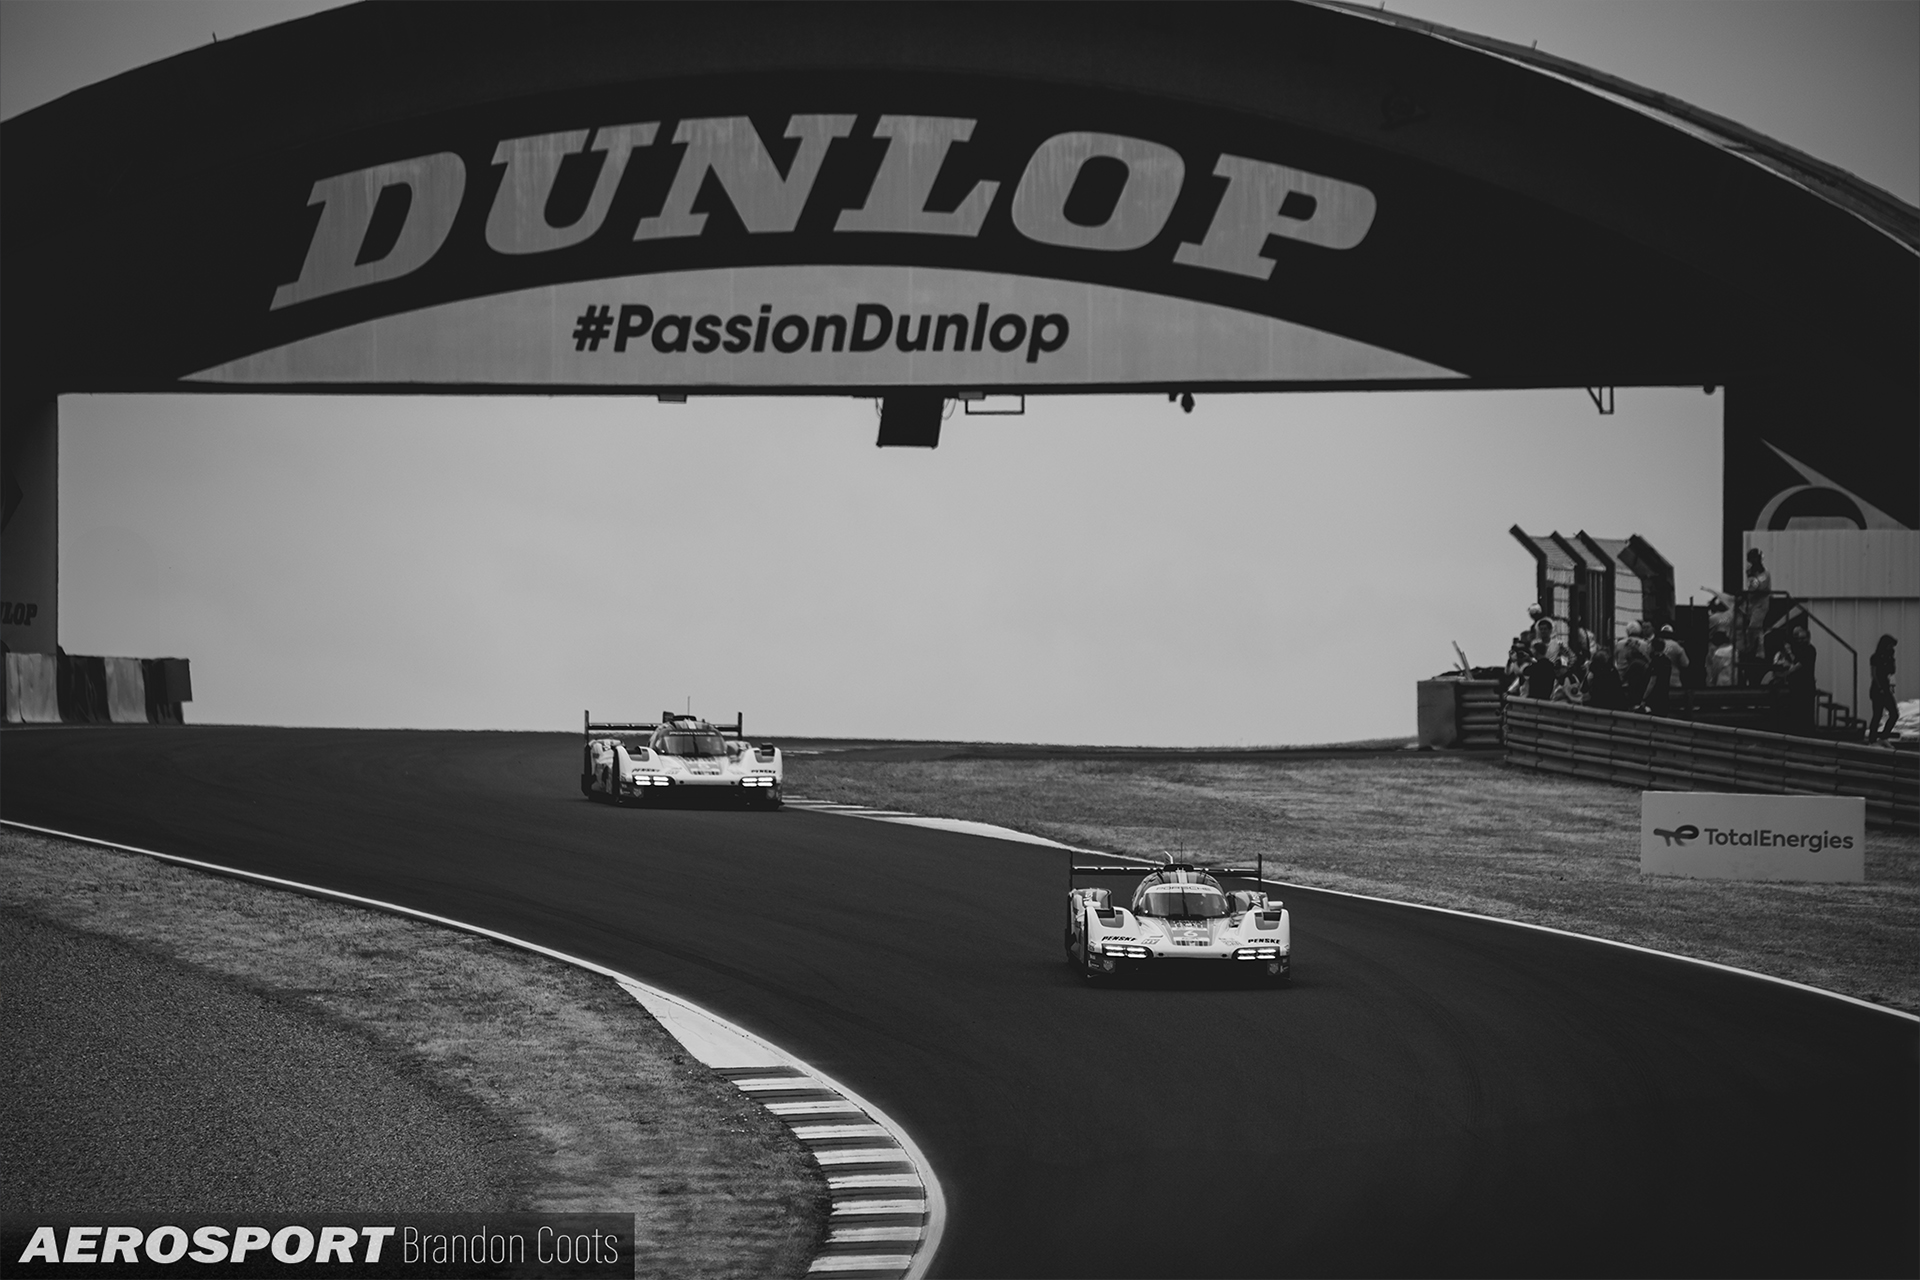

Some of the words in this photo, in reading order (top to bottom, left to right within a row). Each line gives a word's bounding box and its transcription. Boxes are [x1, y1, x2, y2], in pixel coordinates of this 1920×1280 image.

[269, 114, 1377, 311] DUNLOP
[573, 303, 1070, 363] #PassionDunlop
[1703, 828, 1854, 853] TotalEnergies
